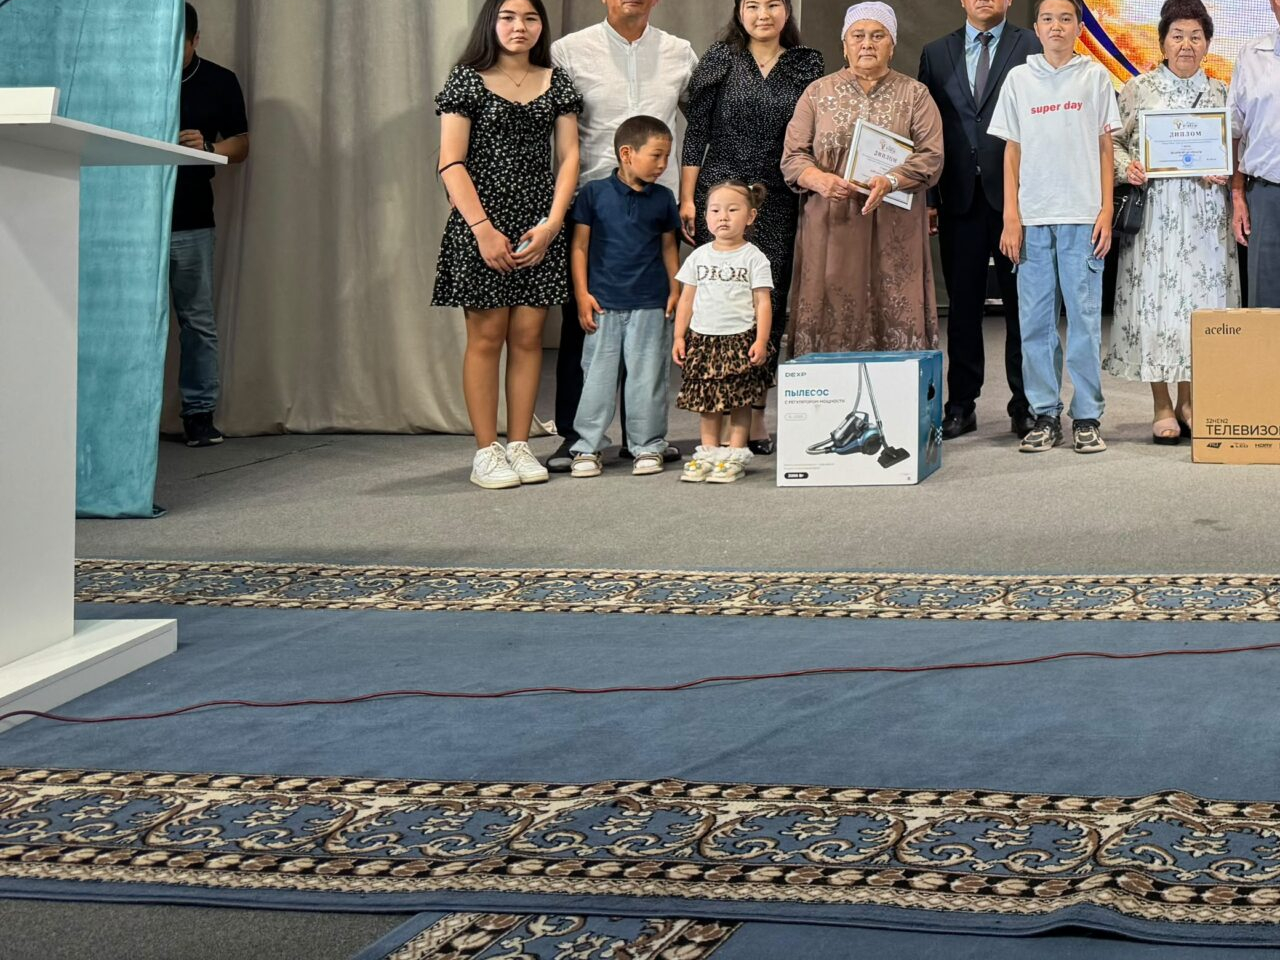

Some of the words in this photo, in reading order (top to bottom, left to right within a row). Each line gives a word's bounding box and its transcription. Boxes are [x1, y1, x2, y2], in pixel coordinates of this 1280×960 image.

[1031, 103, 1061, 114] super
[1064, 101, 1083, 111] day
[696, 264, 749, 282] DIOR
[1204, 323, 1242, 335] aceline
[784, 389, 830, 397] ПЫЛЕСОС
